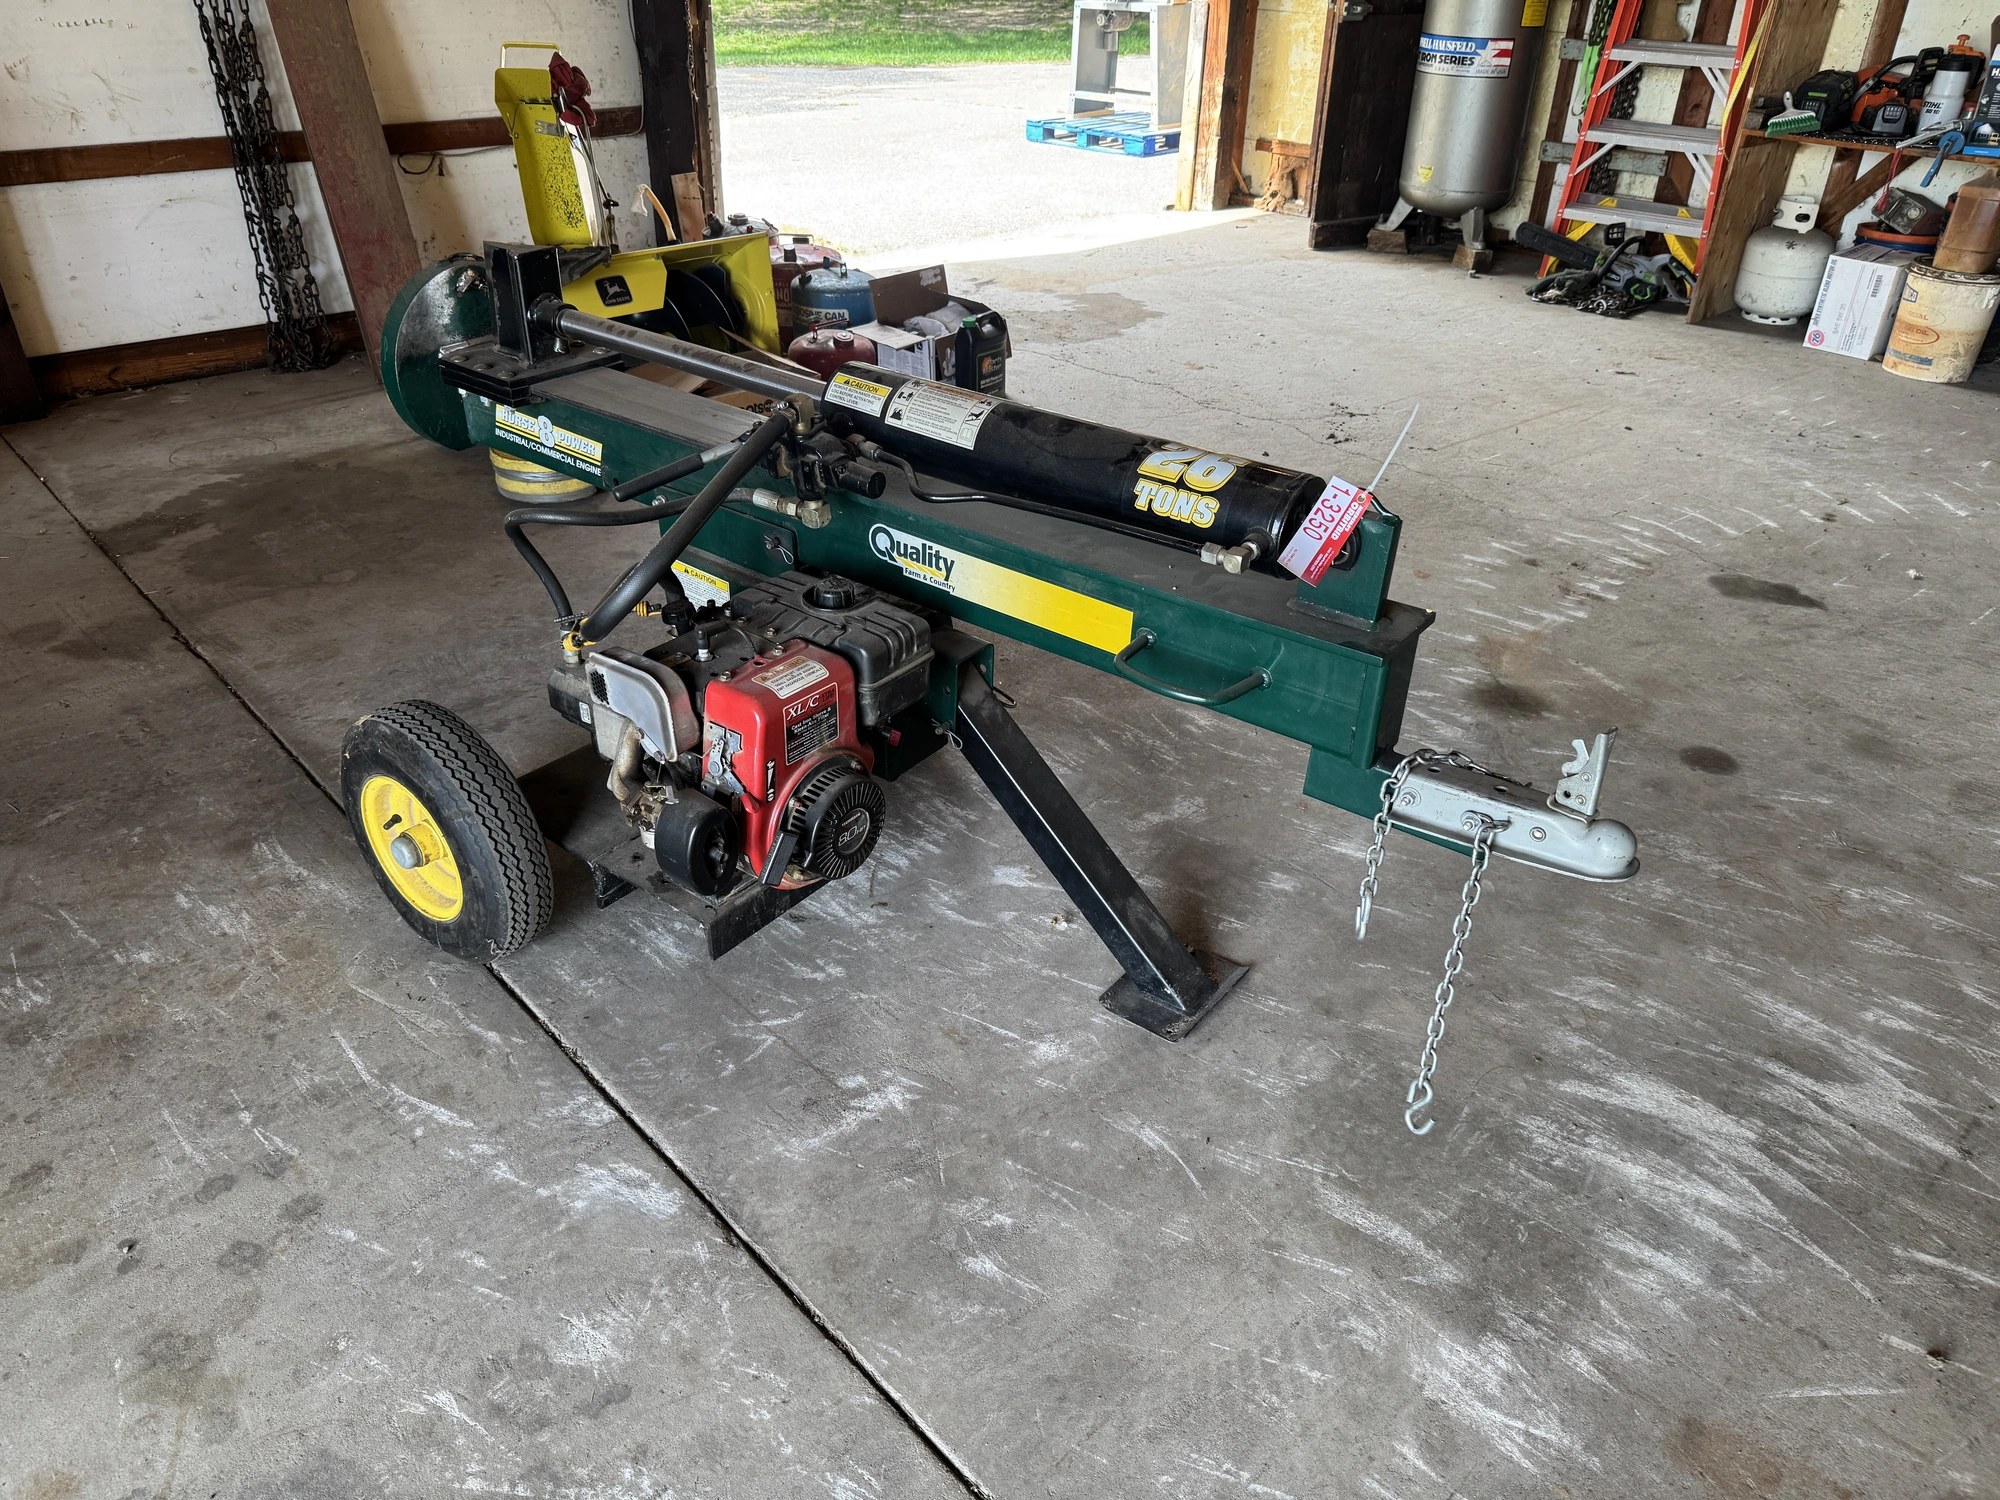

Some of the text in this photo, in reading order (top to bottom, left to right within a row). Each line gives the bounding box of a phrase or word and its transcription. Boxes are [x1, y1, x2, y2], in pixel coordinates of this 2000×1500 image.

[1439, 55, 1476, 66] SERIES
[1922, 101, 1942, 109] STIHL
[824, 312, 845, 320] CAN
[1832, 322, 1840, 334] SAE
[1812, 332, 1820, 344] 76
[850, 380, 879, 393] CAUTION
[537, 416, 555, 448] 8
[558, 432, 596, 456] POWER
[495, 428, 602, 476] INDUSTRIAL/COMMERCIAL ENGINE
[1137, 442, 1251, 492] 26
[1134, 478, 1220, 528] TONS
[1303, 485, 1350, 541] 1-3250
[1331, 501, 1359, 540] ORBITBID
[870, 526, 955, 582] Quality
[690, 570, 716, 586] CAUTION
[905, 568, 921, 579] Farm
[930, 576, 956, 592] Country
